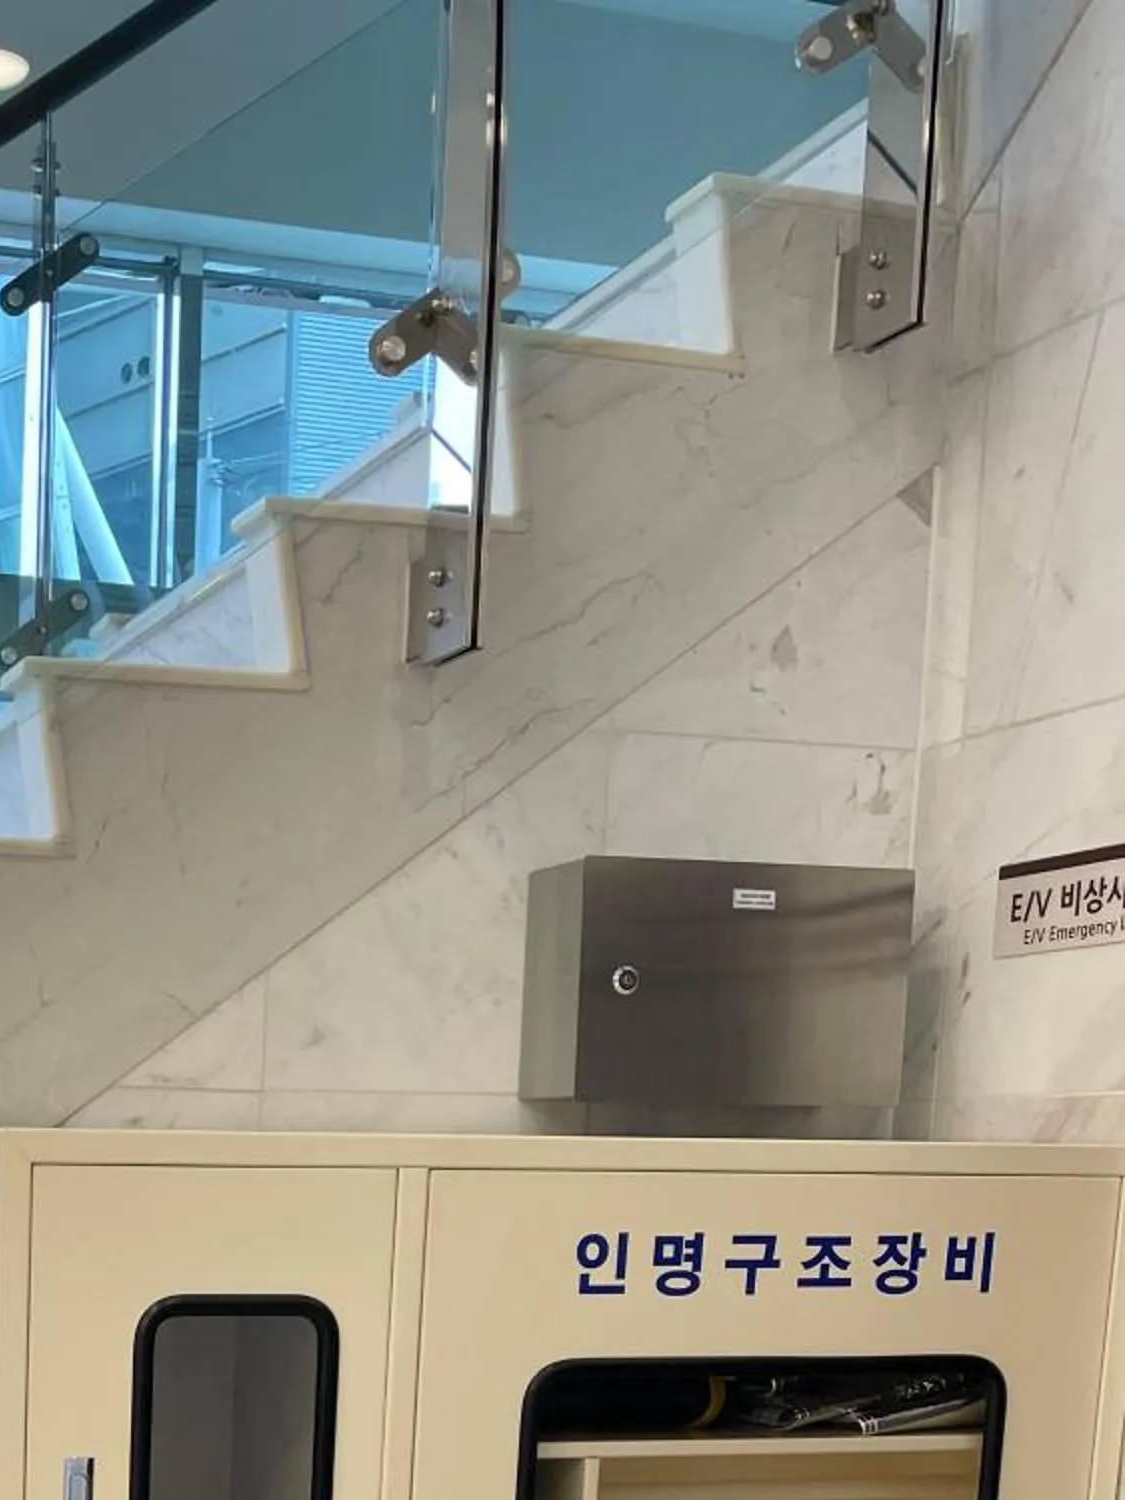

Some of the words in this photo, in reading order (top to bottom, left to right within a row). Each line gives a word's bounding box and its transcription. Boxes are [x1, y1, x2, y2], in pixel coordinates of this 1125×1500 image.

[1010, 888, 1052, 922] E/V
[1024, 927, 1046, 945] E/V
[1049, 919, 1117, 941] Emergency
